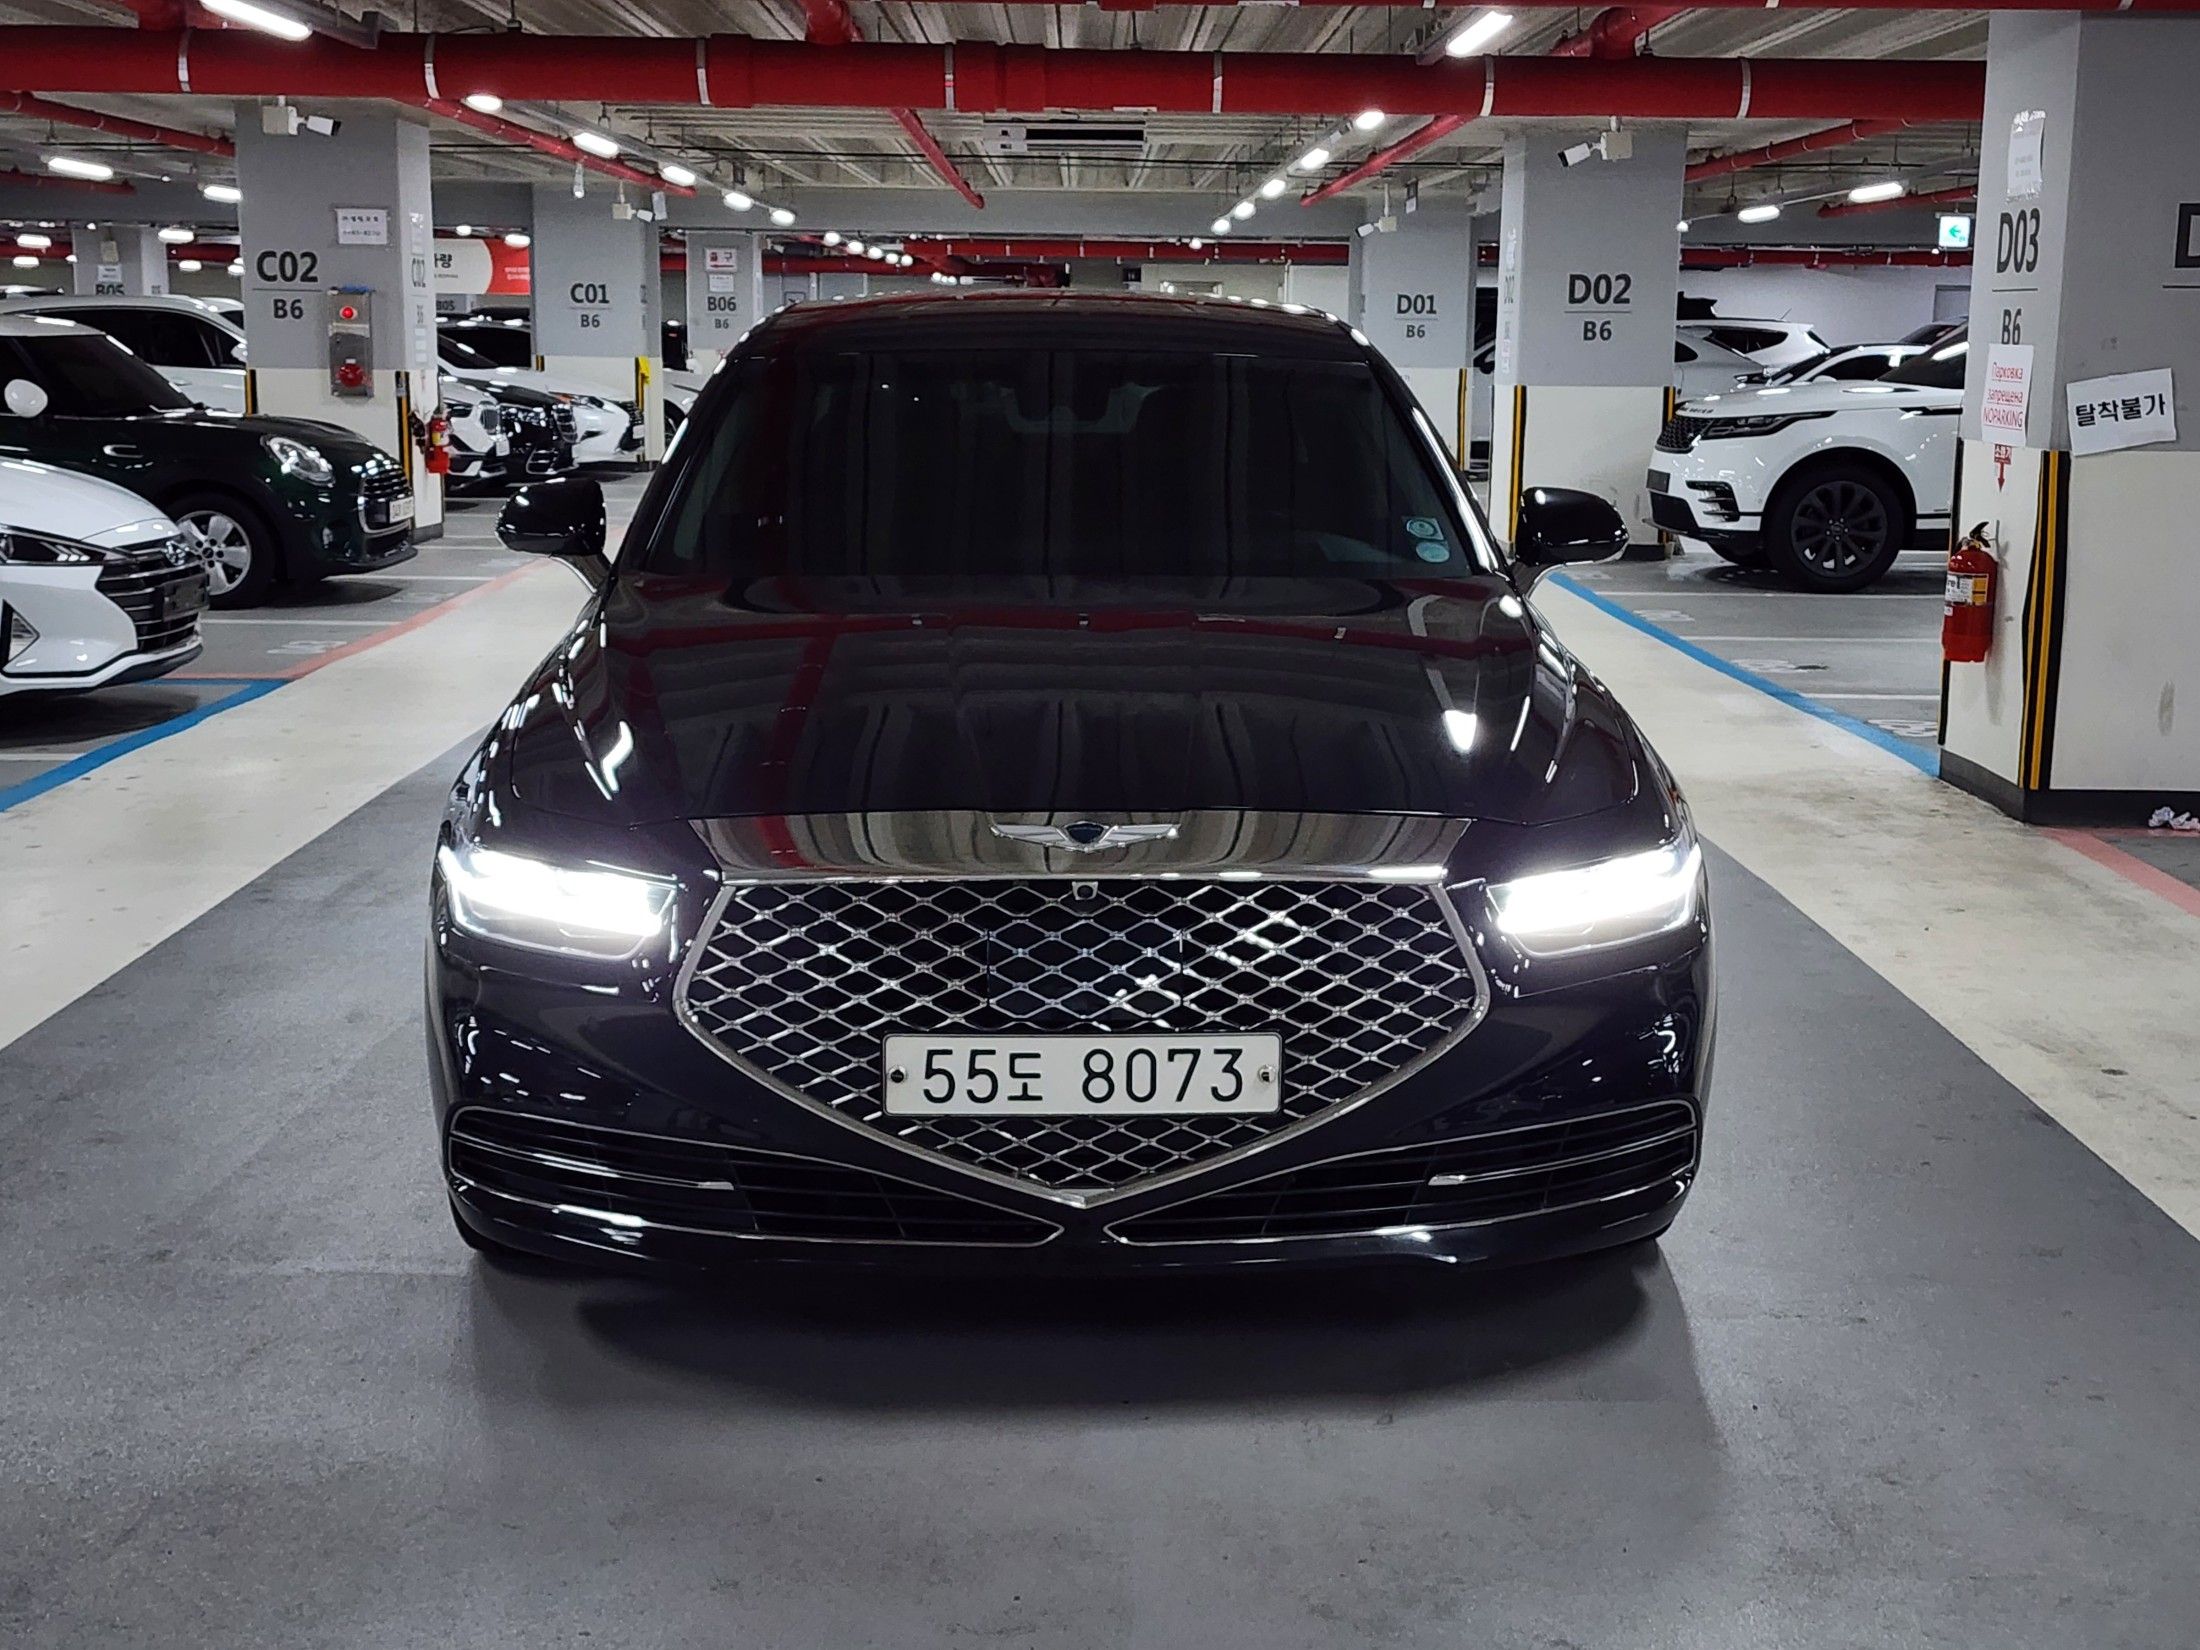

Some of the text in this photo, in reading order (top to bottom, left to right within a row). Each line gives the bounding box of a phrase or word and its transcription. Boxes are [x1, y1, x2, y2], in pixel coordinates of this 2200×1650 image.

[1997, 208, 2040, 273] D03
[257, 251, 318, 282] C02
[434, 252, 453, 269] 량
[570, 283, 610, 303] C01
[1569, 274, 1631, 304] D02
[274, 299, 303, 319] B6
[707, 296, 737, 311] B06
[1396, 294, 1437, 314] D01
[580, 314, 601, 328] B6
[715, 319, 730, 330] B6
[1584, 321, 1612, 341] B6
[2001, 309, 2022, 345] B6
[1406, 325, 1426, 338] B6
[2075, 393, 2166, 427] 탈착불가
[923, 1048, 1244, 1104] 55도 8073
